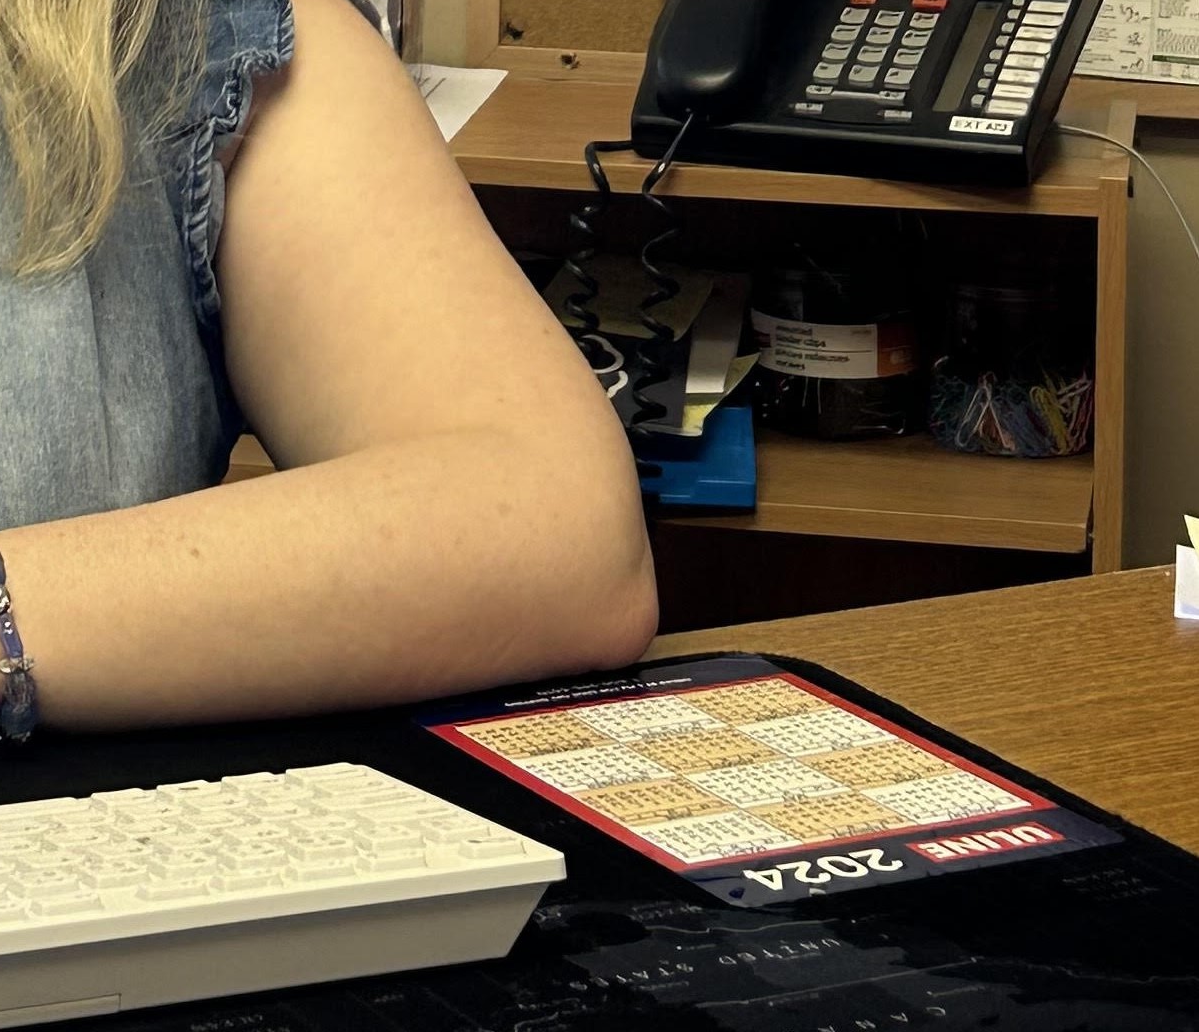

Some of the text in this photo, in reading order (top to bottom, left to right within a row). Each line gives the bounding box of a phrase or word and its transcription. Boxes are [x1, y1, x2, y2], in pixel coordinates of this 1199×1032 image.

[918, 825, 1053, 859] ULINE
[743, 848, 903, 891] 2024
[719, 939, 841, 965] UNITED
